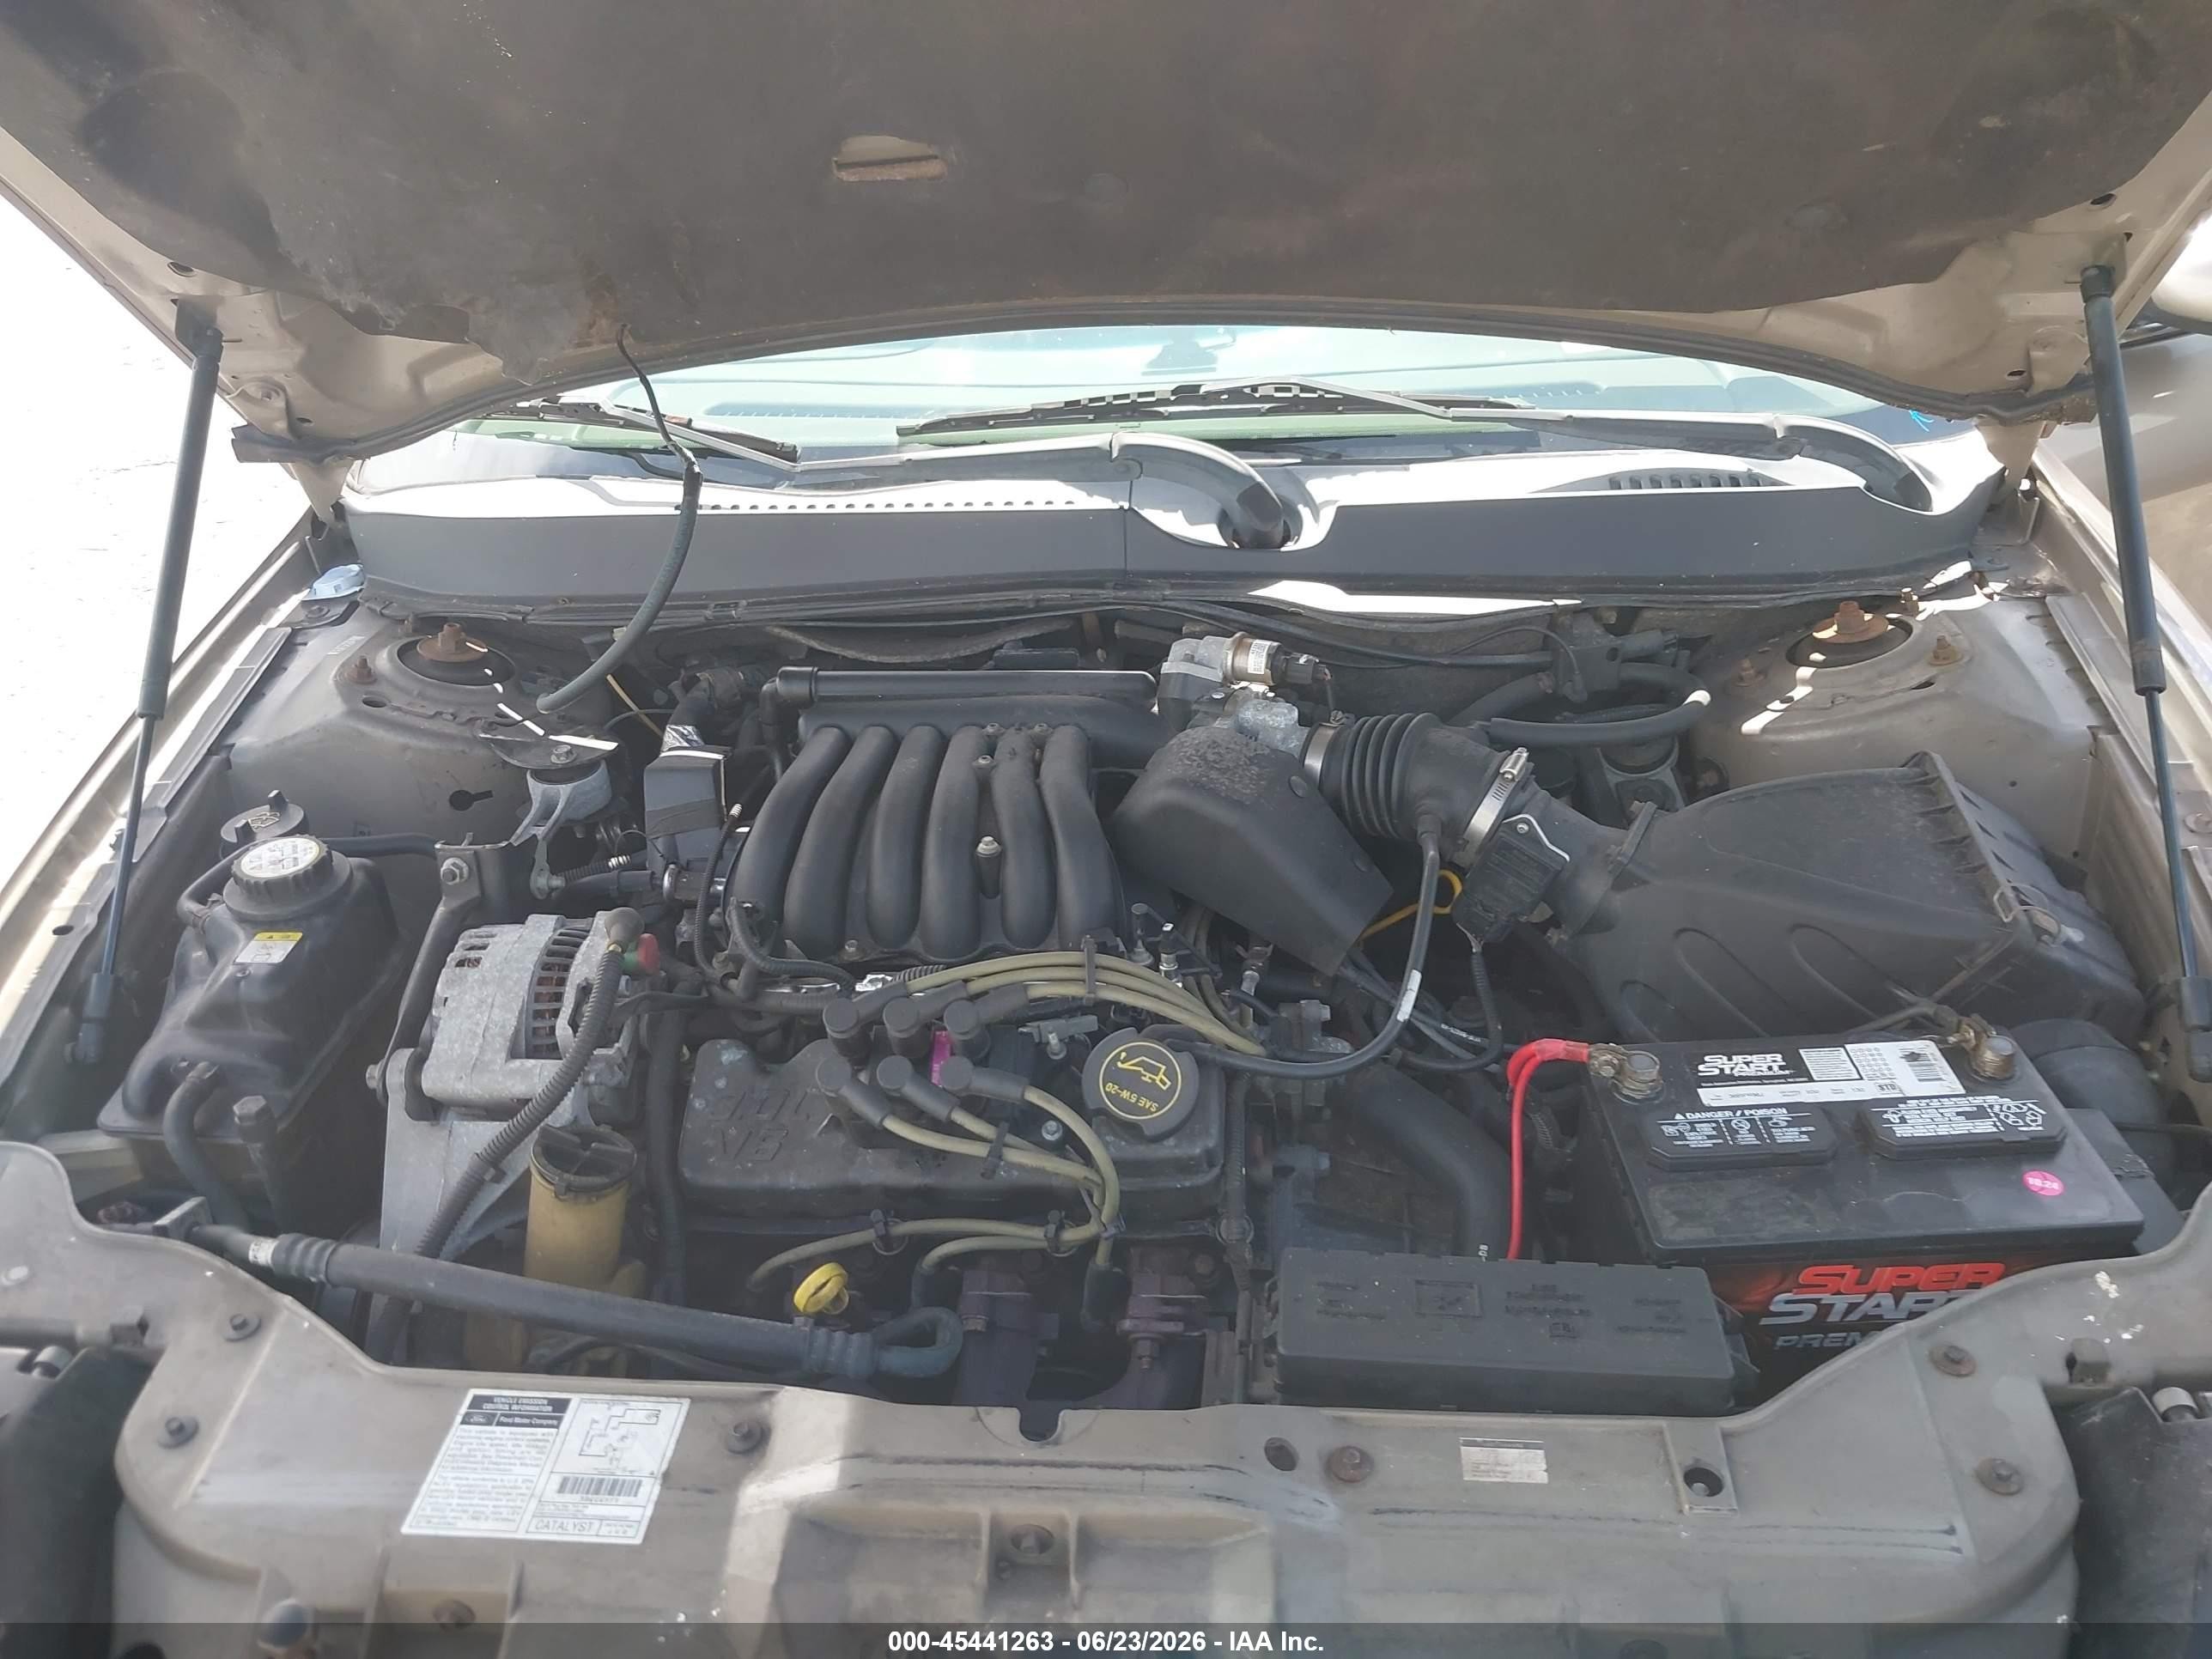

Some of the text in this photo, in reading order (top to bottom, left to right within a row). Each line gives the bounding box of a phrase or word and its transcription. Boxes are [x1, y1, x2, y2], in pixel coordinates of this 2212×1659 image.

[1704, 1054, 1783, 1065] SUPER
[1698, 1063, 1786, 1076] START
[1105, 1082, 1159, 1112] SAE 5W-20
[1686, 1110, 1734, 1120] DANGER
[1745, 1107, 1789, 1116] POISON
[1796, 1262, 2005, 1295] SUPER
[1759, 1290, 1978, 1325] STAR
[534, 1519, 594, 1534] CATALYST
